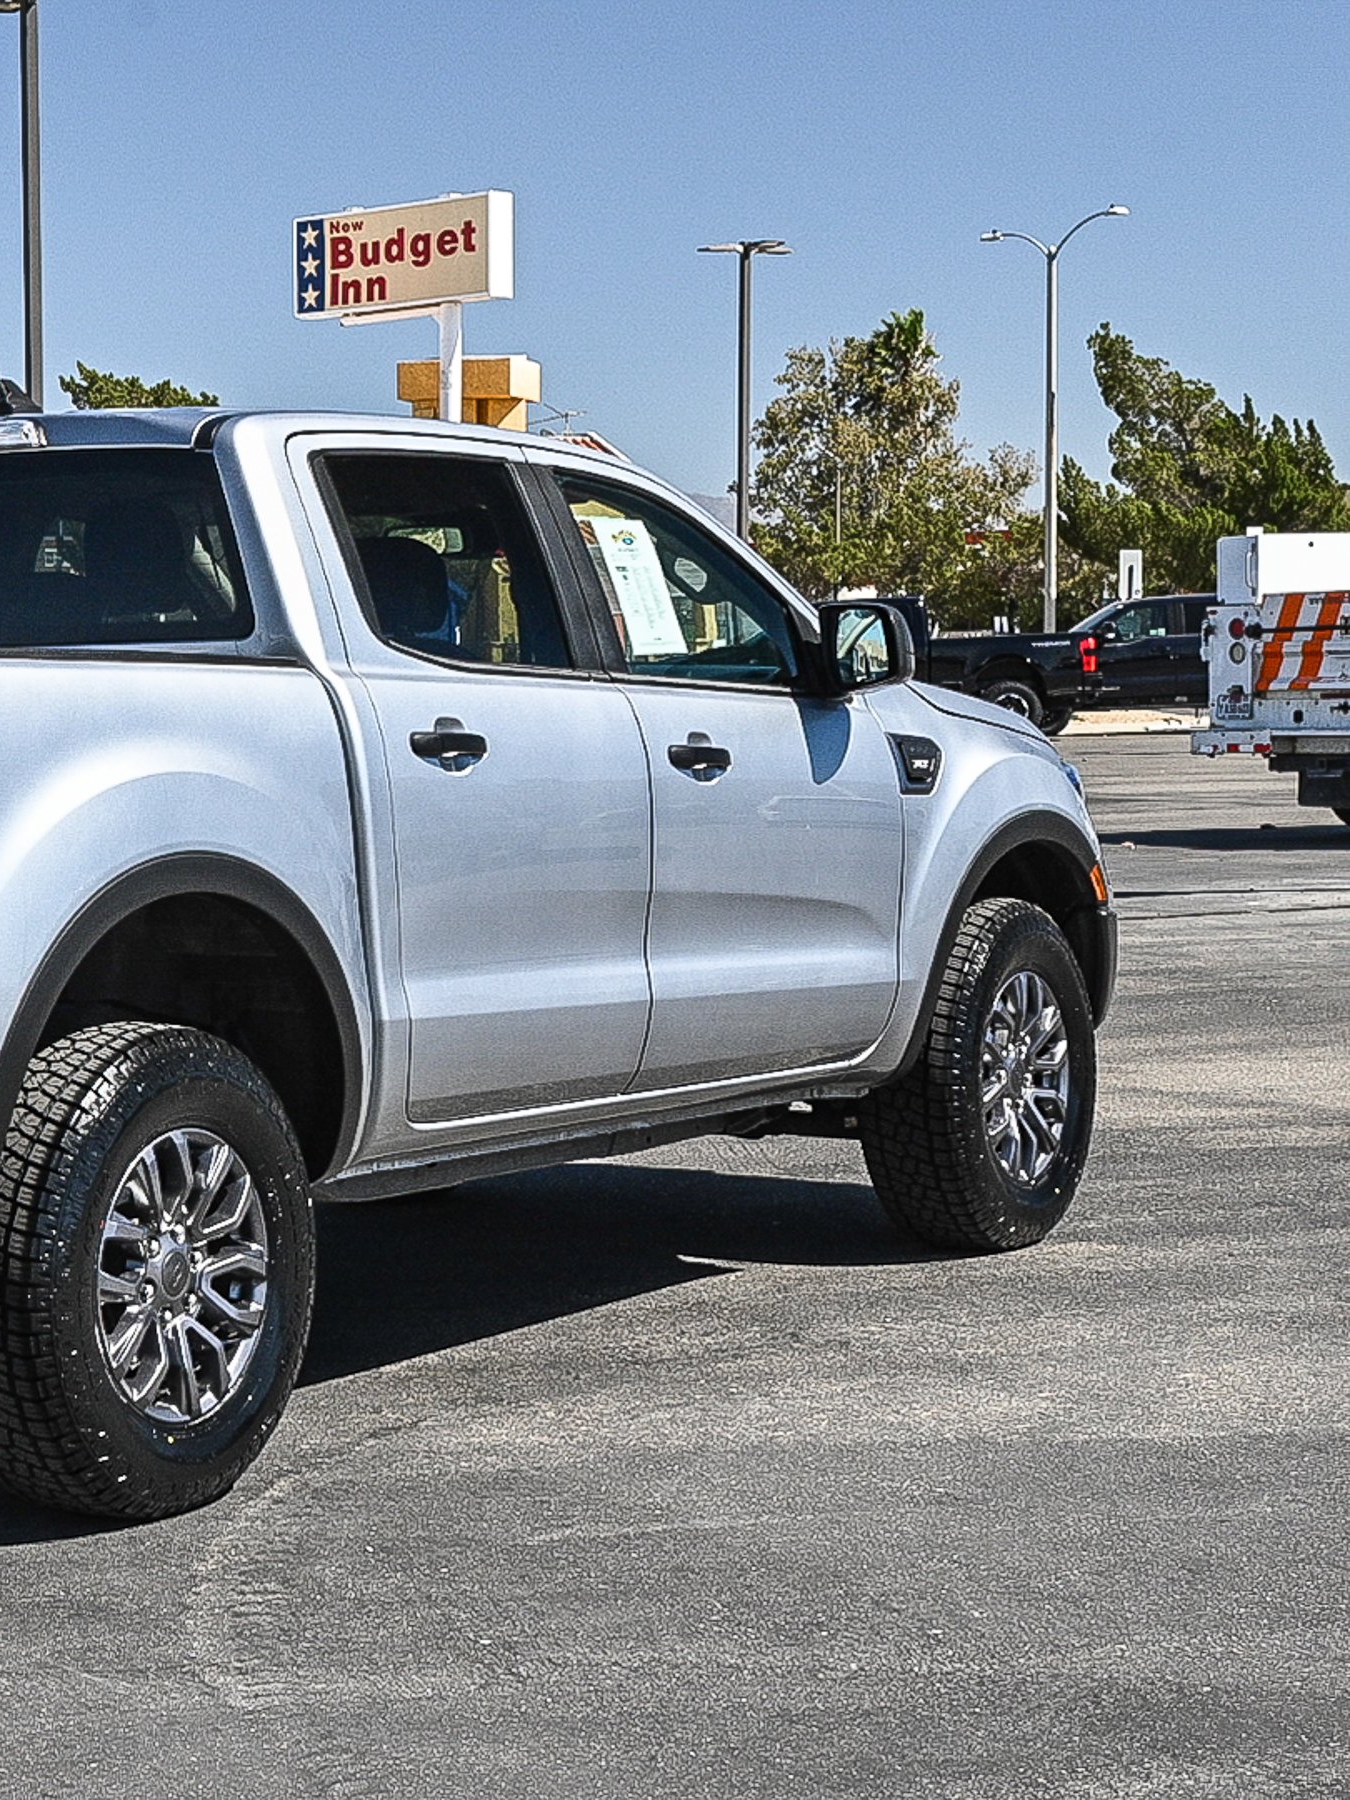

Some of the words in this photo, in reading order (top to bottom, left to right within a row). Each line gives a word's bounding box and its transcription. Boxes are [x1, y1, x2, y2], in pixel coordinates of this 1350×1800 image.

[329, 220, 364, 234] Now
[329, 219, 477, 270] Budget
[329, 273, 387, 307] Inn
